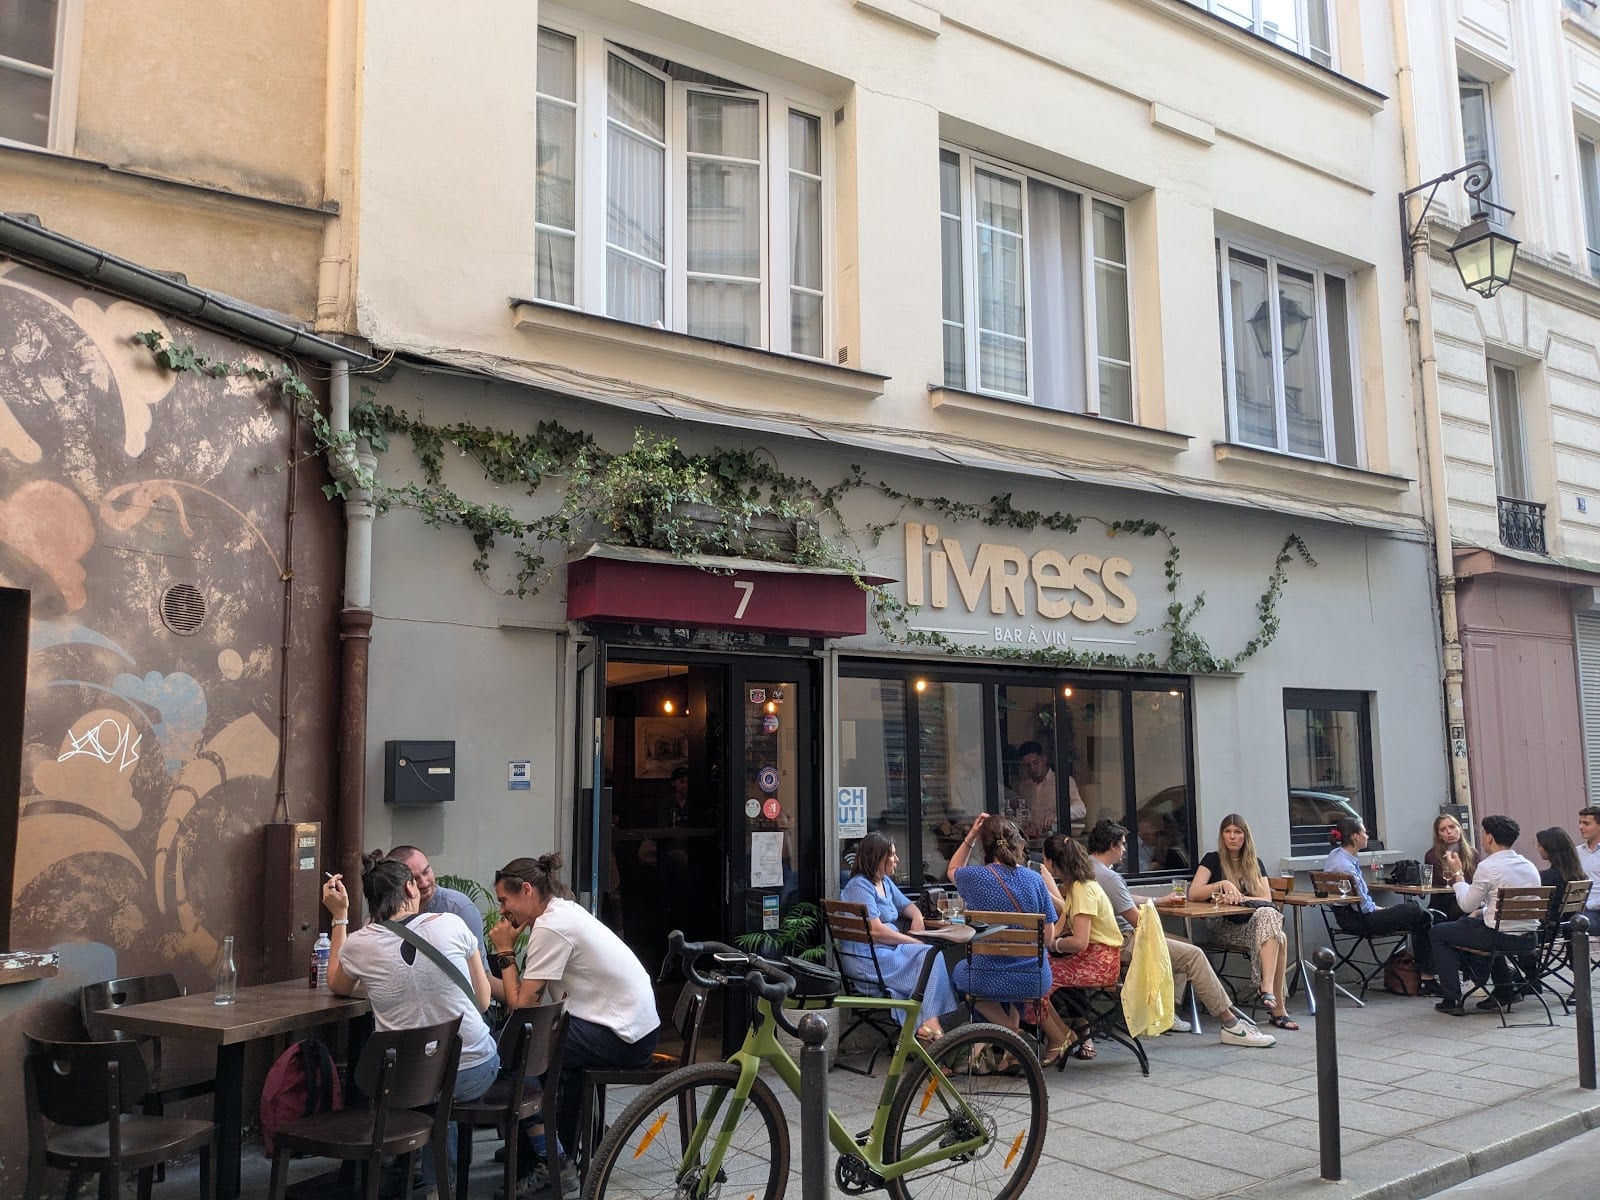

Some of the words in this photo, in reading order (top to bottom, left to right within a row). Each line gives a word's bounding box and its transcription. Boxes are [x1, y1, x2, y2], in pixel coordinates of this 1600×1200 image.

[733, 580, 754, 619] 7
[994, 626, 1023, 643] BAR
[1027, 624, 1038, 644] À
[1041, 629, 1067, 645] VIN
[838, 788, 864, 806] CH
[838, 806, 865, 824] UT!
